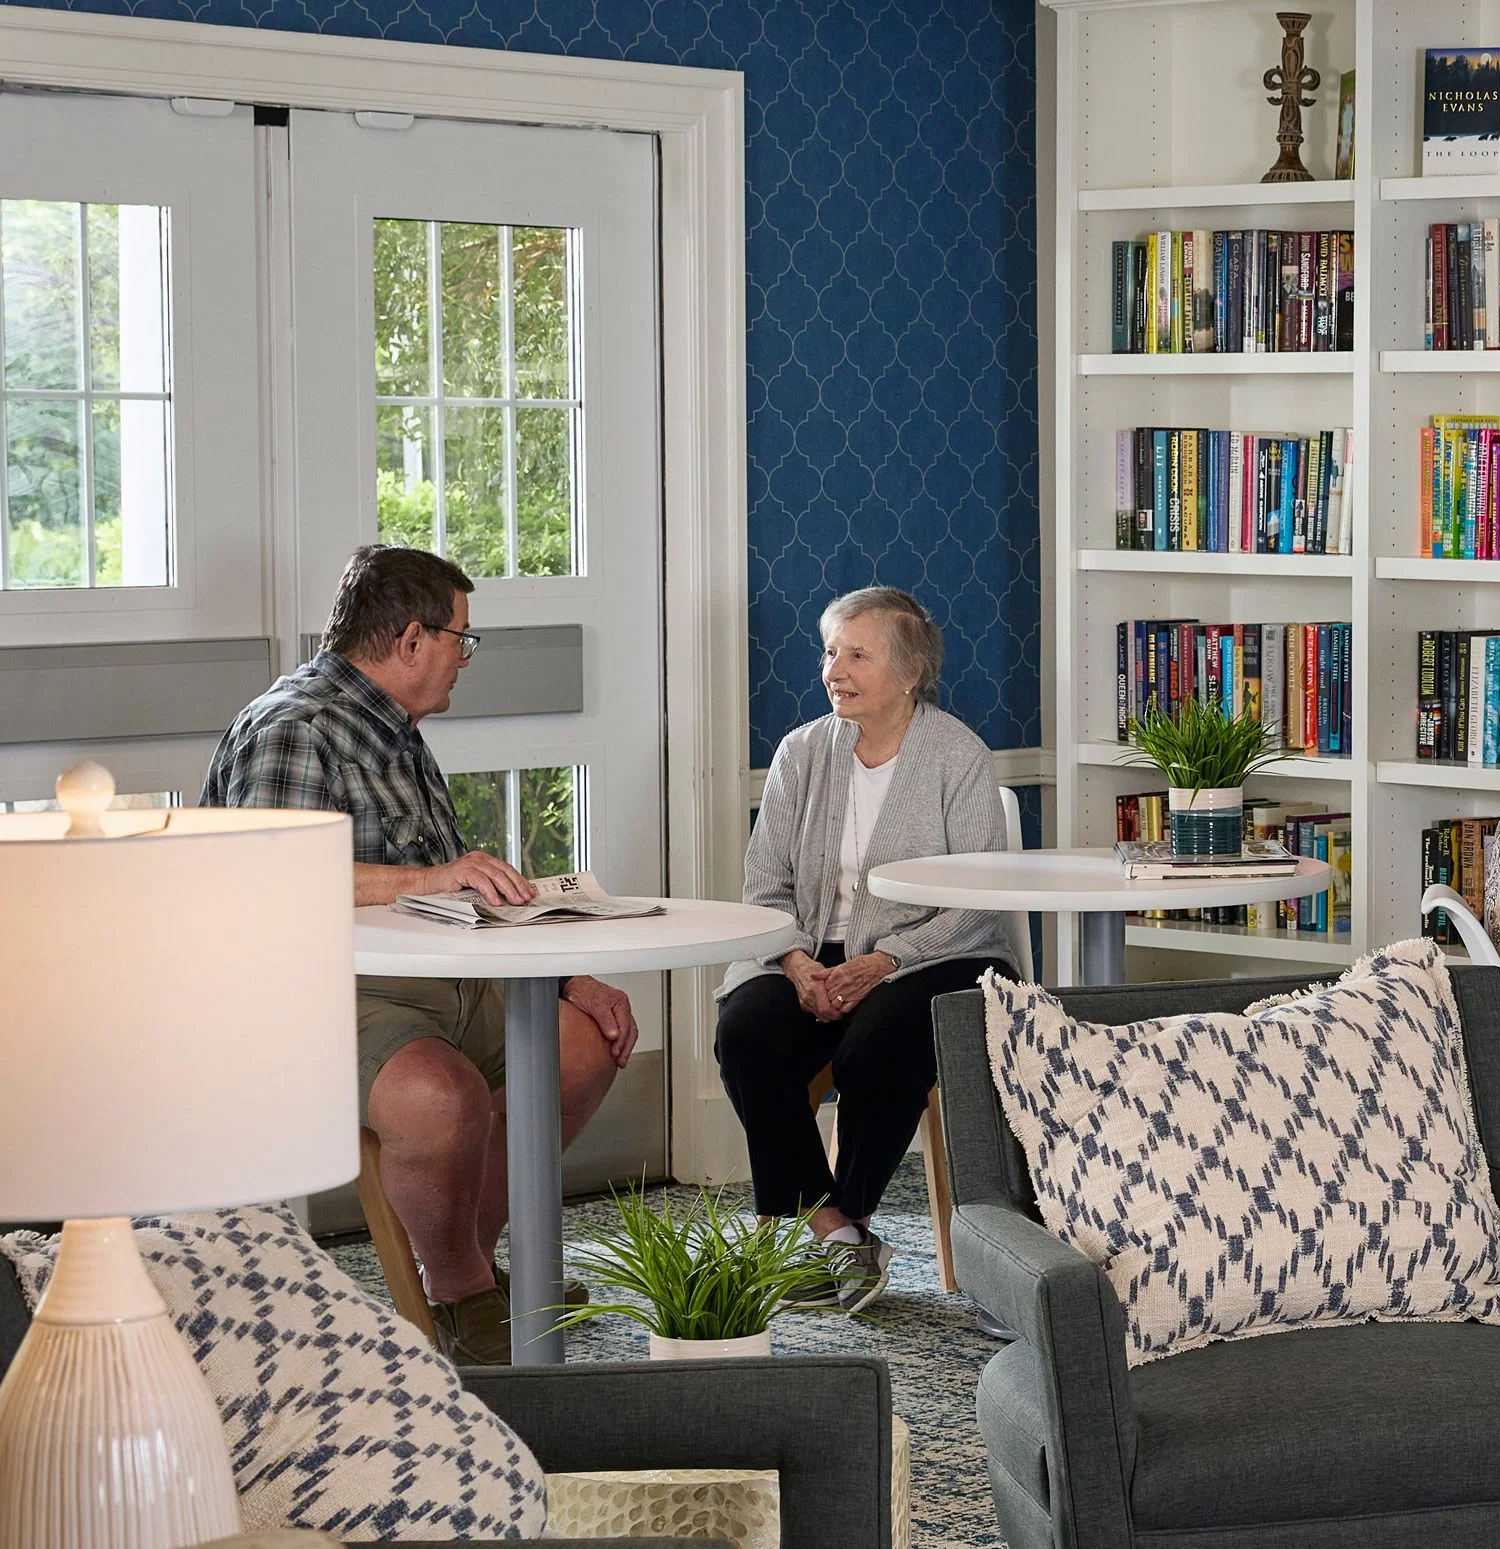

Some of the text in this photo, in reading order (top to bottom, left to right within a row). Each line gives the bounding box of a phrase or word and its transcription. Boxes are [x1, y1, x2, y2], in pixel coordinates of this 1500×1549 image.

[1428, 90, 1499, 101] NICHOLAS
[1442, 103, 1484, 112] EVANS
[1300, 234, 1311, 288] JOHN SANDFORD
[1433, 426, 1442, 516] JANET EVANOVICH
[1443, 440, 1453, 530] JANET EVANOVICH
[1169, 498, 1180, 532] CRISIS
[1421, 640, 1435, 696] ROBERT LUDLUM
[1118, 674, 1126, 728] QUEEN NIGHT
[1306, 689, 1314, 698] V
[1470, 667, 1479, 746] ELIZABETH GEORGE
[1420, 712, 1428, 745] DIRECTIVE
[1458, 729, 1463, 741] Me
[1463, 824, 1474, 869] DAN BROWN
